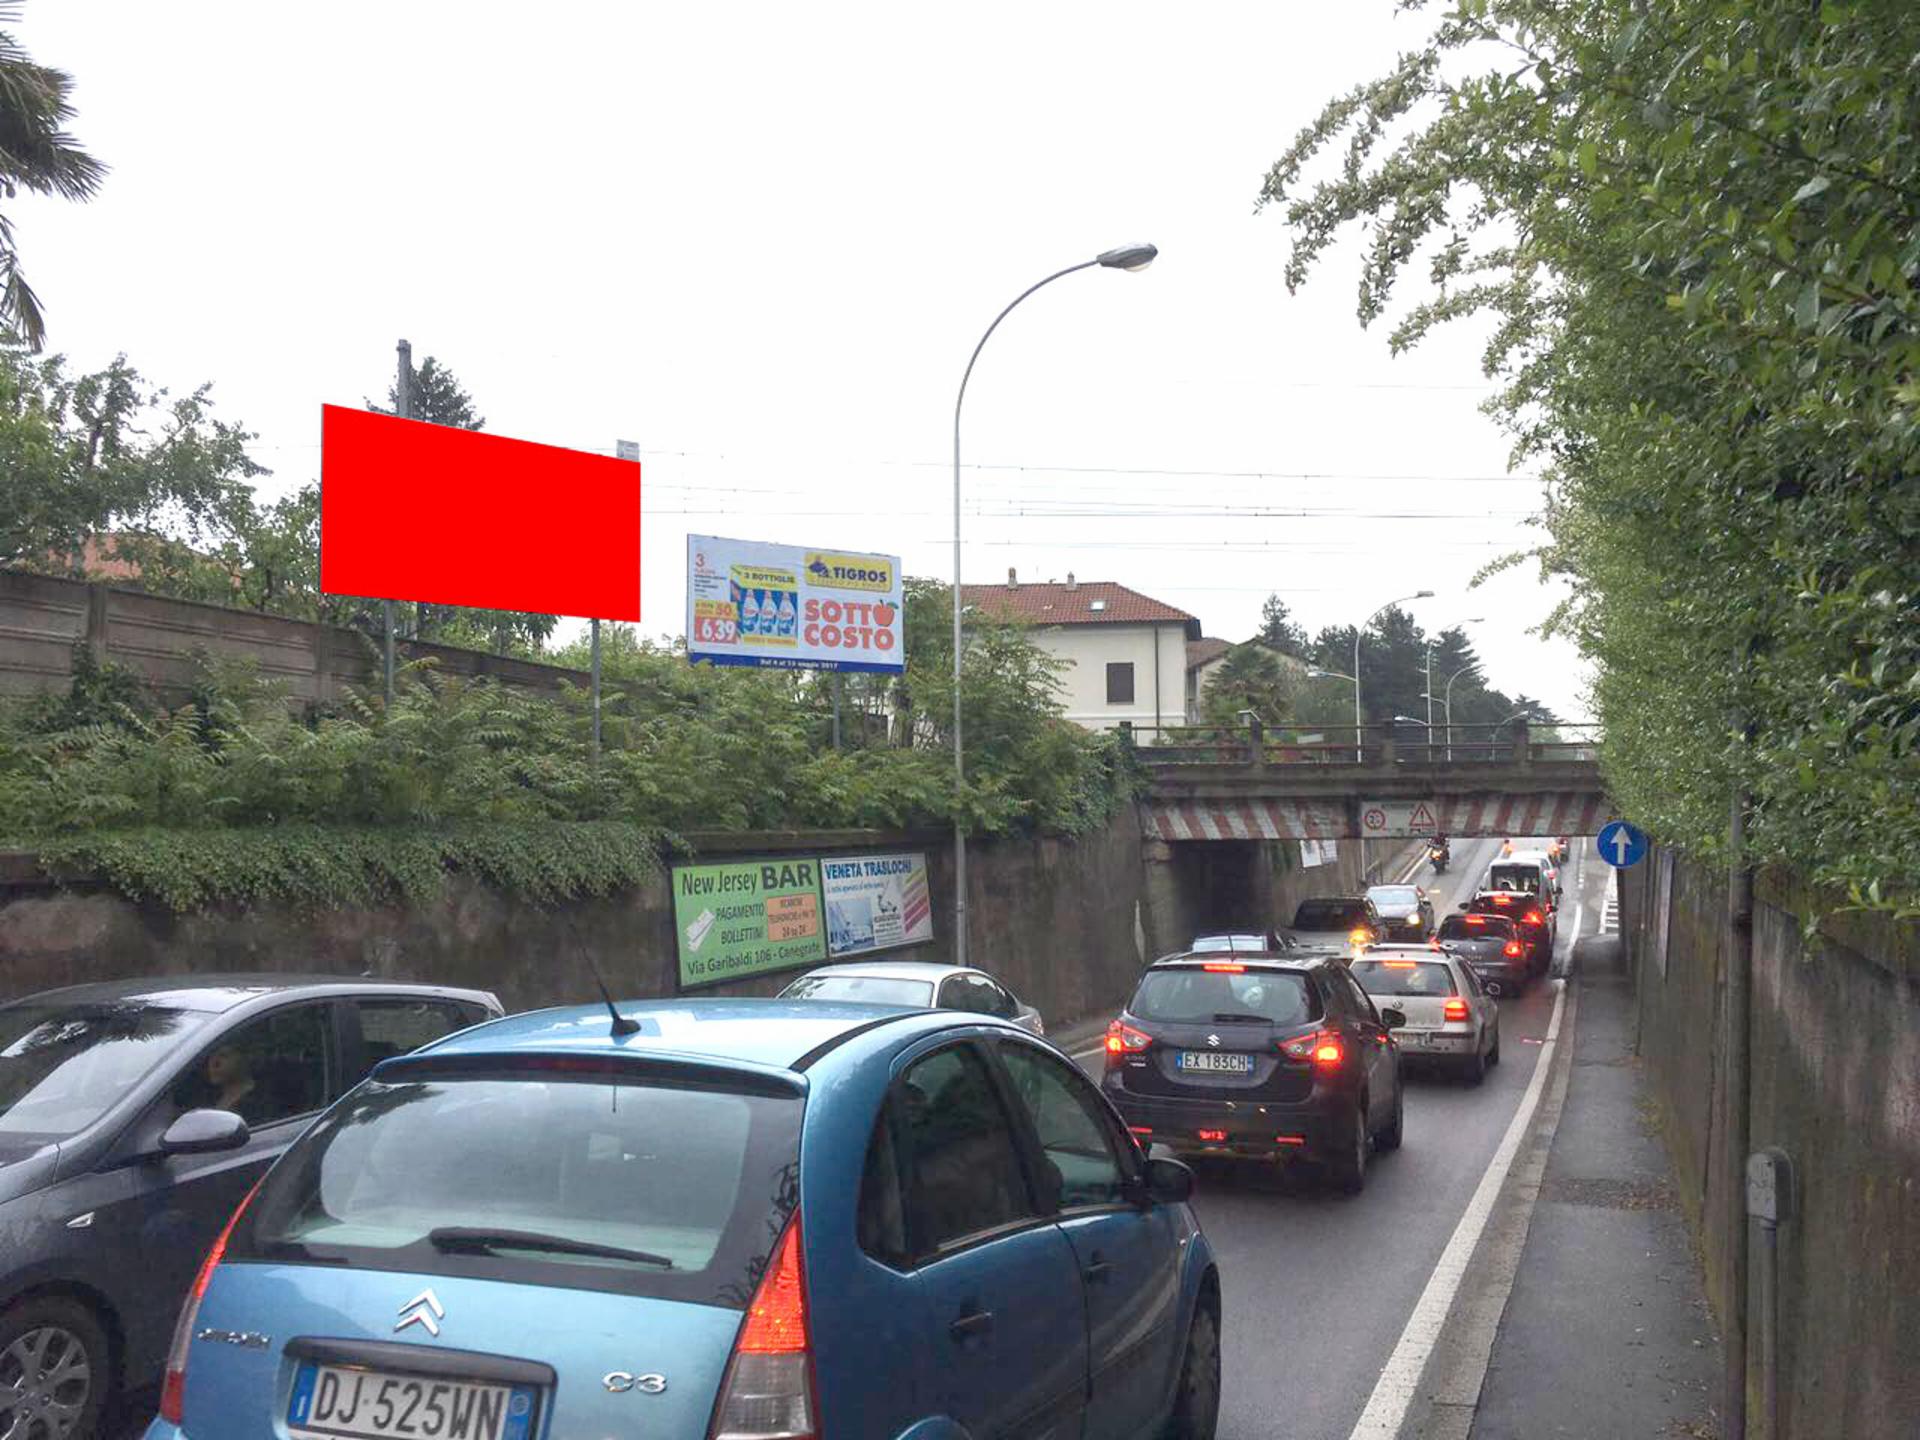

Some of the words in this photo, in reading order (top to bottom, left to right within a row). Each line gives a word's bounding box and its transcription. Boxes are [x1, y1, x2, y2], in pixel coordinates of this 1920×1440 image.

[832, 566, 887, 582] TIGROS
[804, 623, 895, 650] COSTO
[682, 873, 715, 896] New
[718, 869, 757, 896] Jersey
[760, 863, 814, 890] BAR
[824, 862, 863, 879] VENETA
[863, 859, 912, 877] TRASLOCHI
[716, 902, 765, 921] PAGAMENTO
[687, 961, 705, 976] Via
[707, 950, 753, 972] Garibaldi
[754, 948, 772, 964] 106
[1184, 1052, 1200, 1067] EX
[1206, 1054, 1247, 1070] 183CH
[602, 1371, 669, 1394] C3
